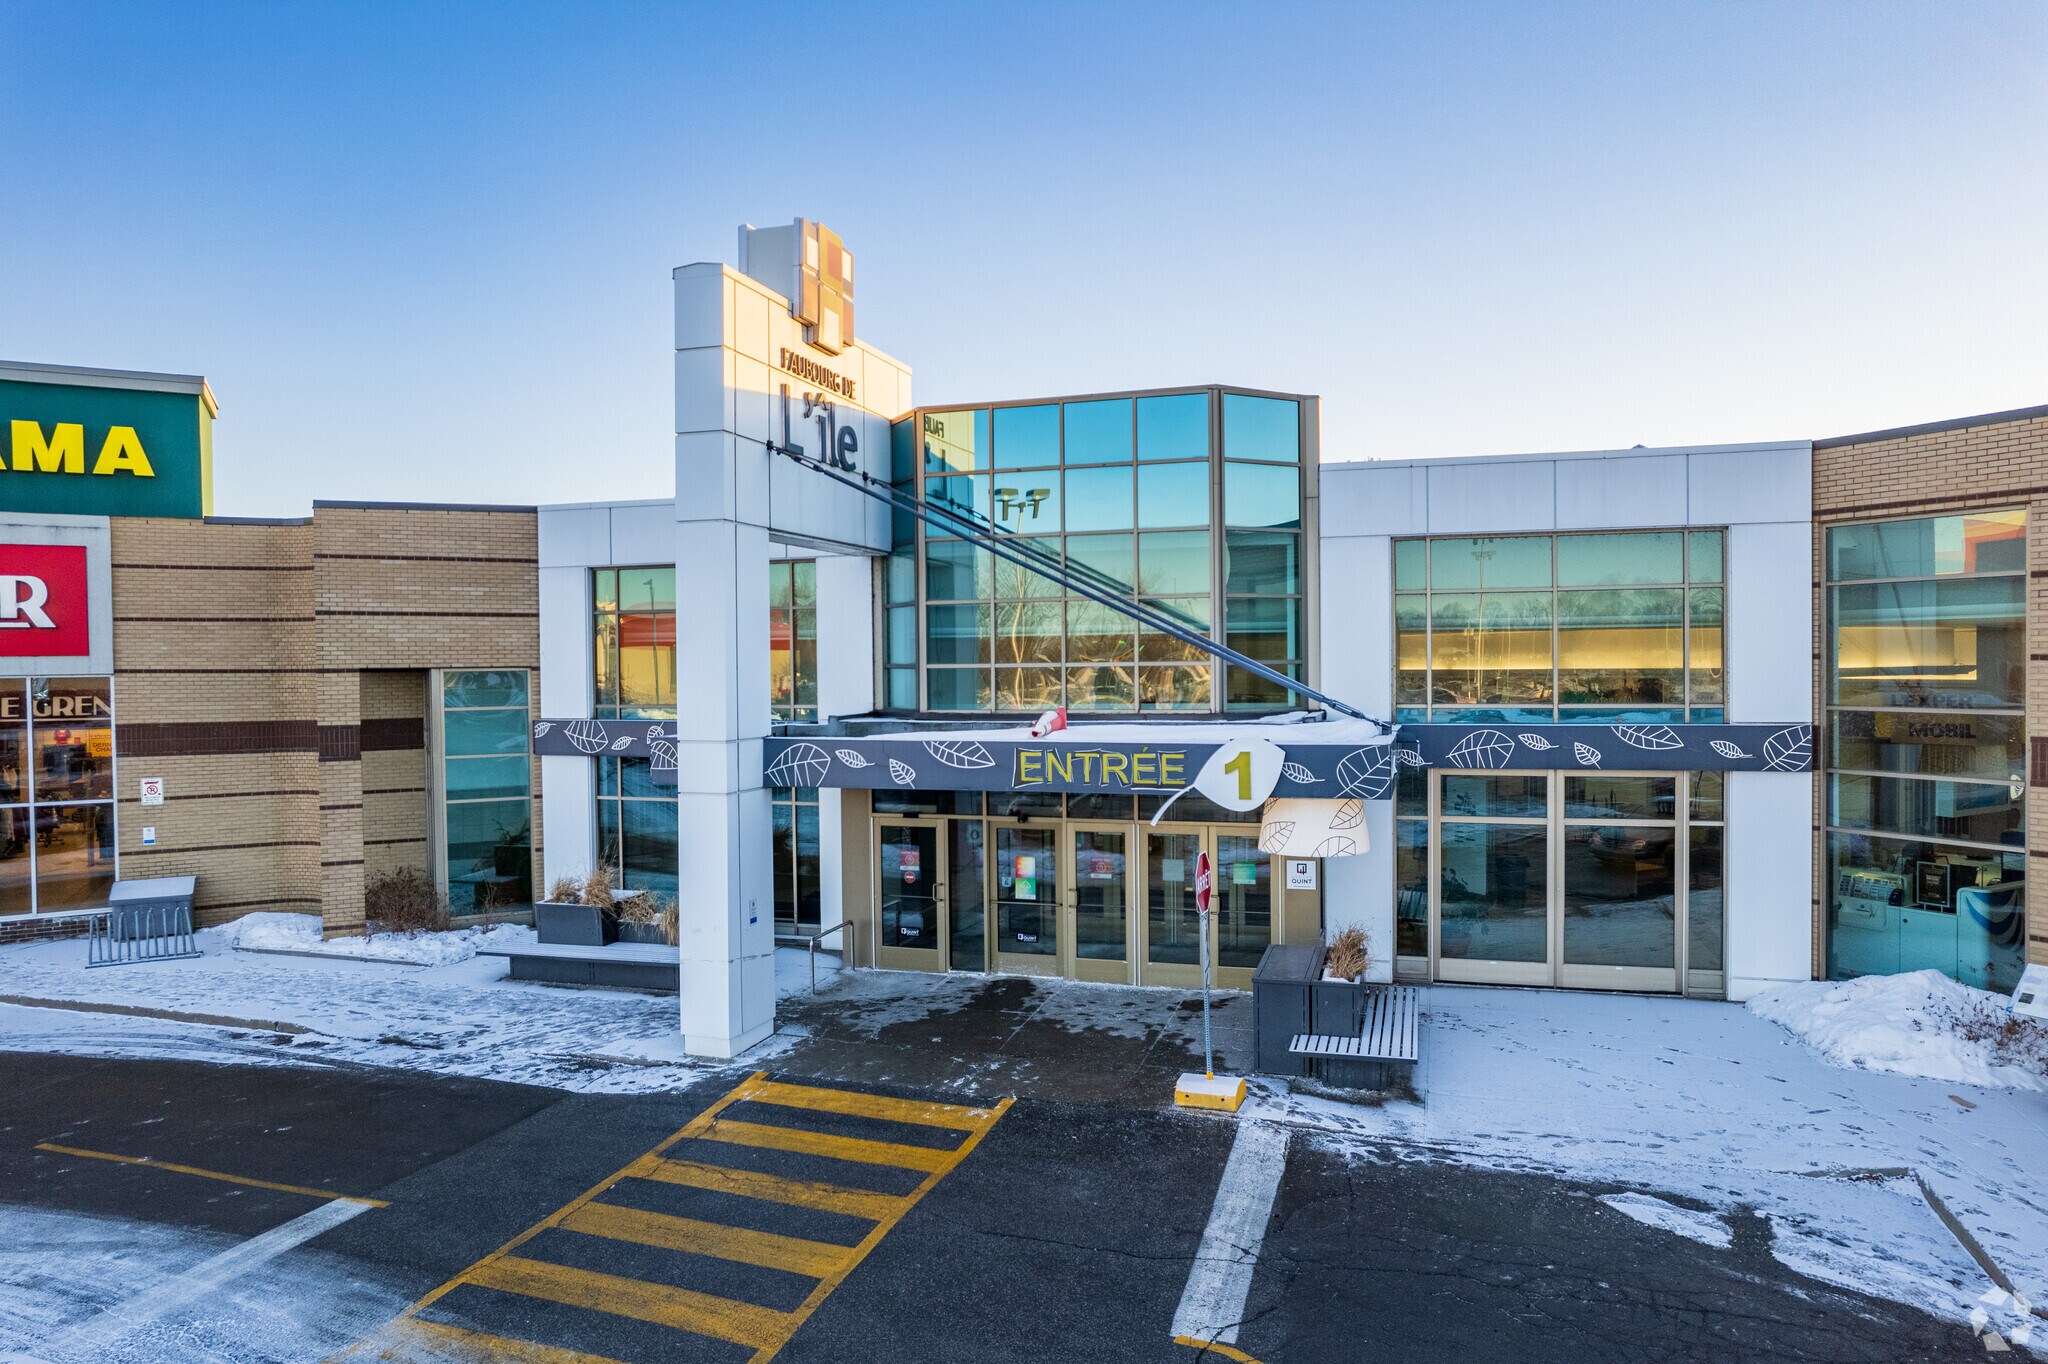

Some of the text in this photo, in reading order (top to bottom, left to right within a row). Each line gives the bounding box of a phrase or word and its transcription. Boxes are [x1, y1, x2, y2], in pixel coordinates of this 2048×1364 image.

[780, 347, 857, 400] FAUBOURG DE
[0, 419, 156, 477] MA
[1018, 746, 1252, 800] ENTRÉE 1
